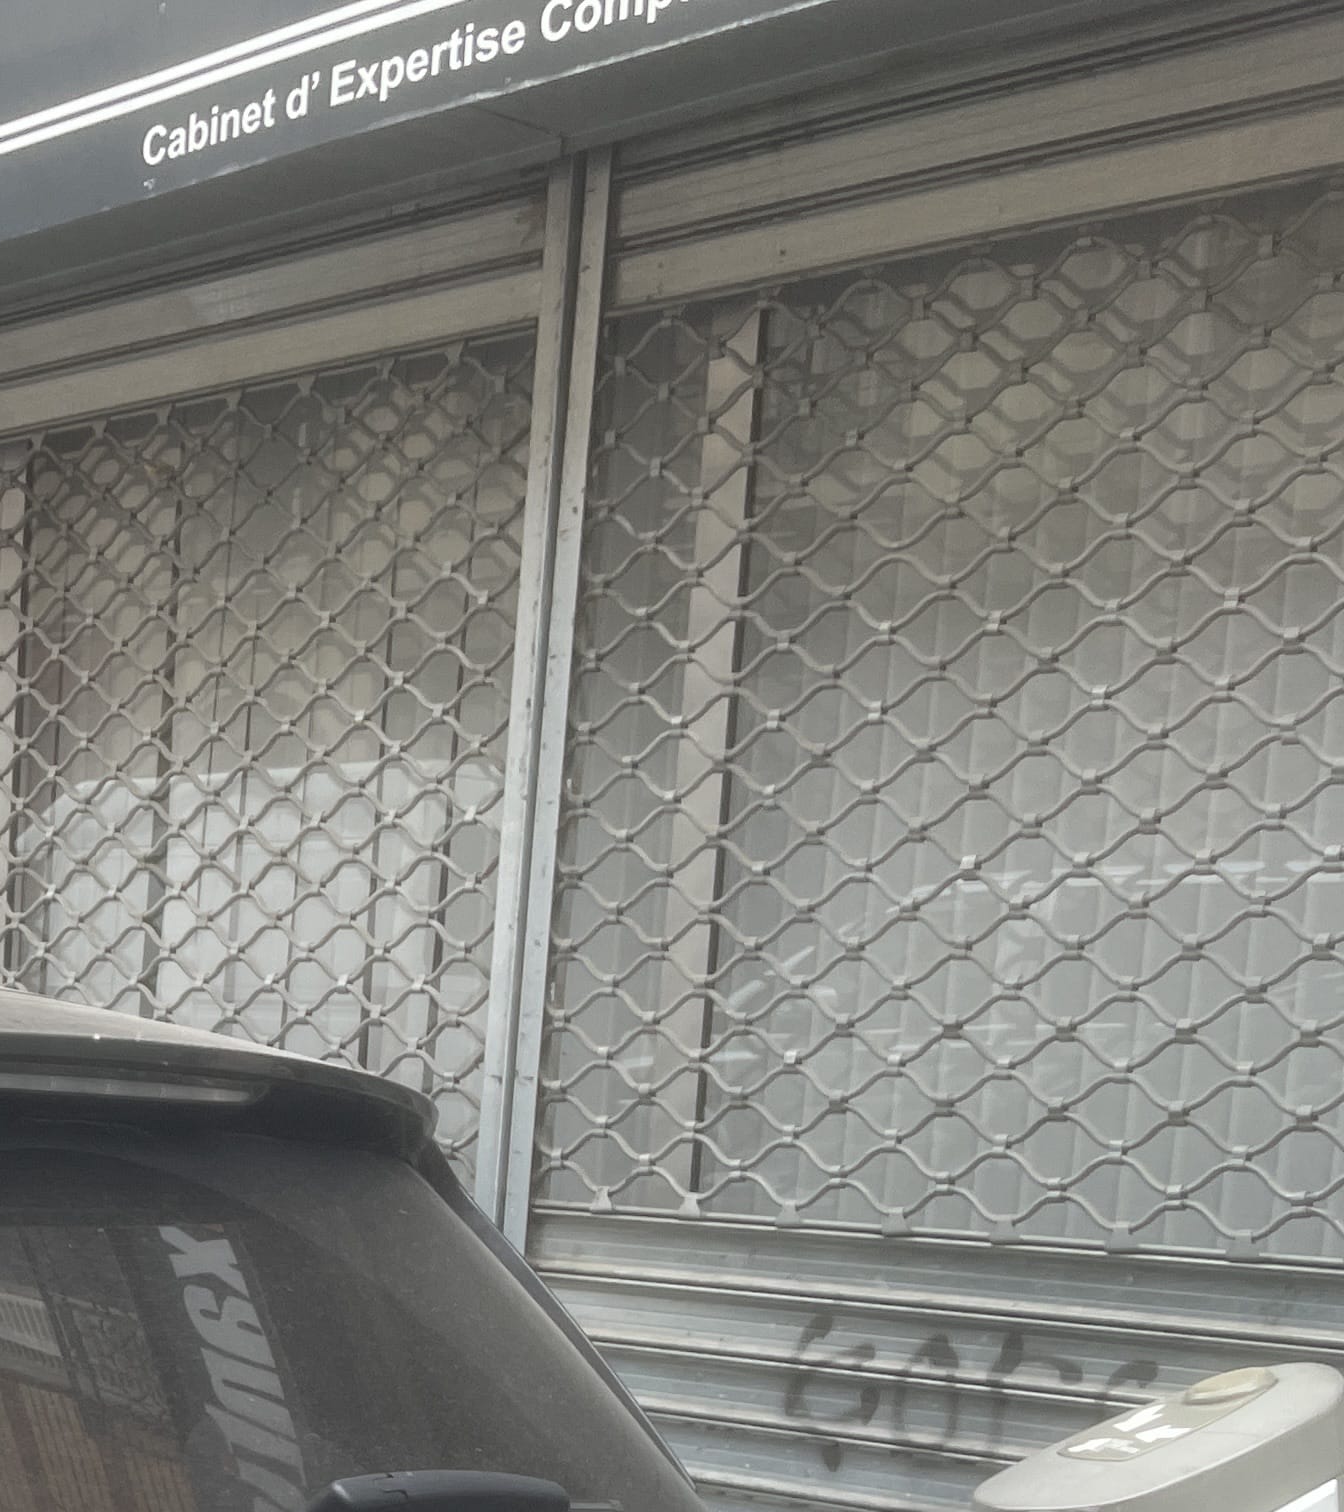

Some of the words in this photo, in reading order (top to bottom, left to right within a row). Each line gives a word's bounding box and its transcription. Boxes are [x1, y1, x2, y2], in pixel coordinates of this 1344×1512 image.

[142, 88, 277, 165] Cabinet
[329, 18, 526, 107] Expertise
[540, 0, 689, 42] Comp
